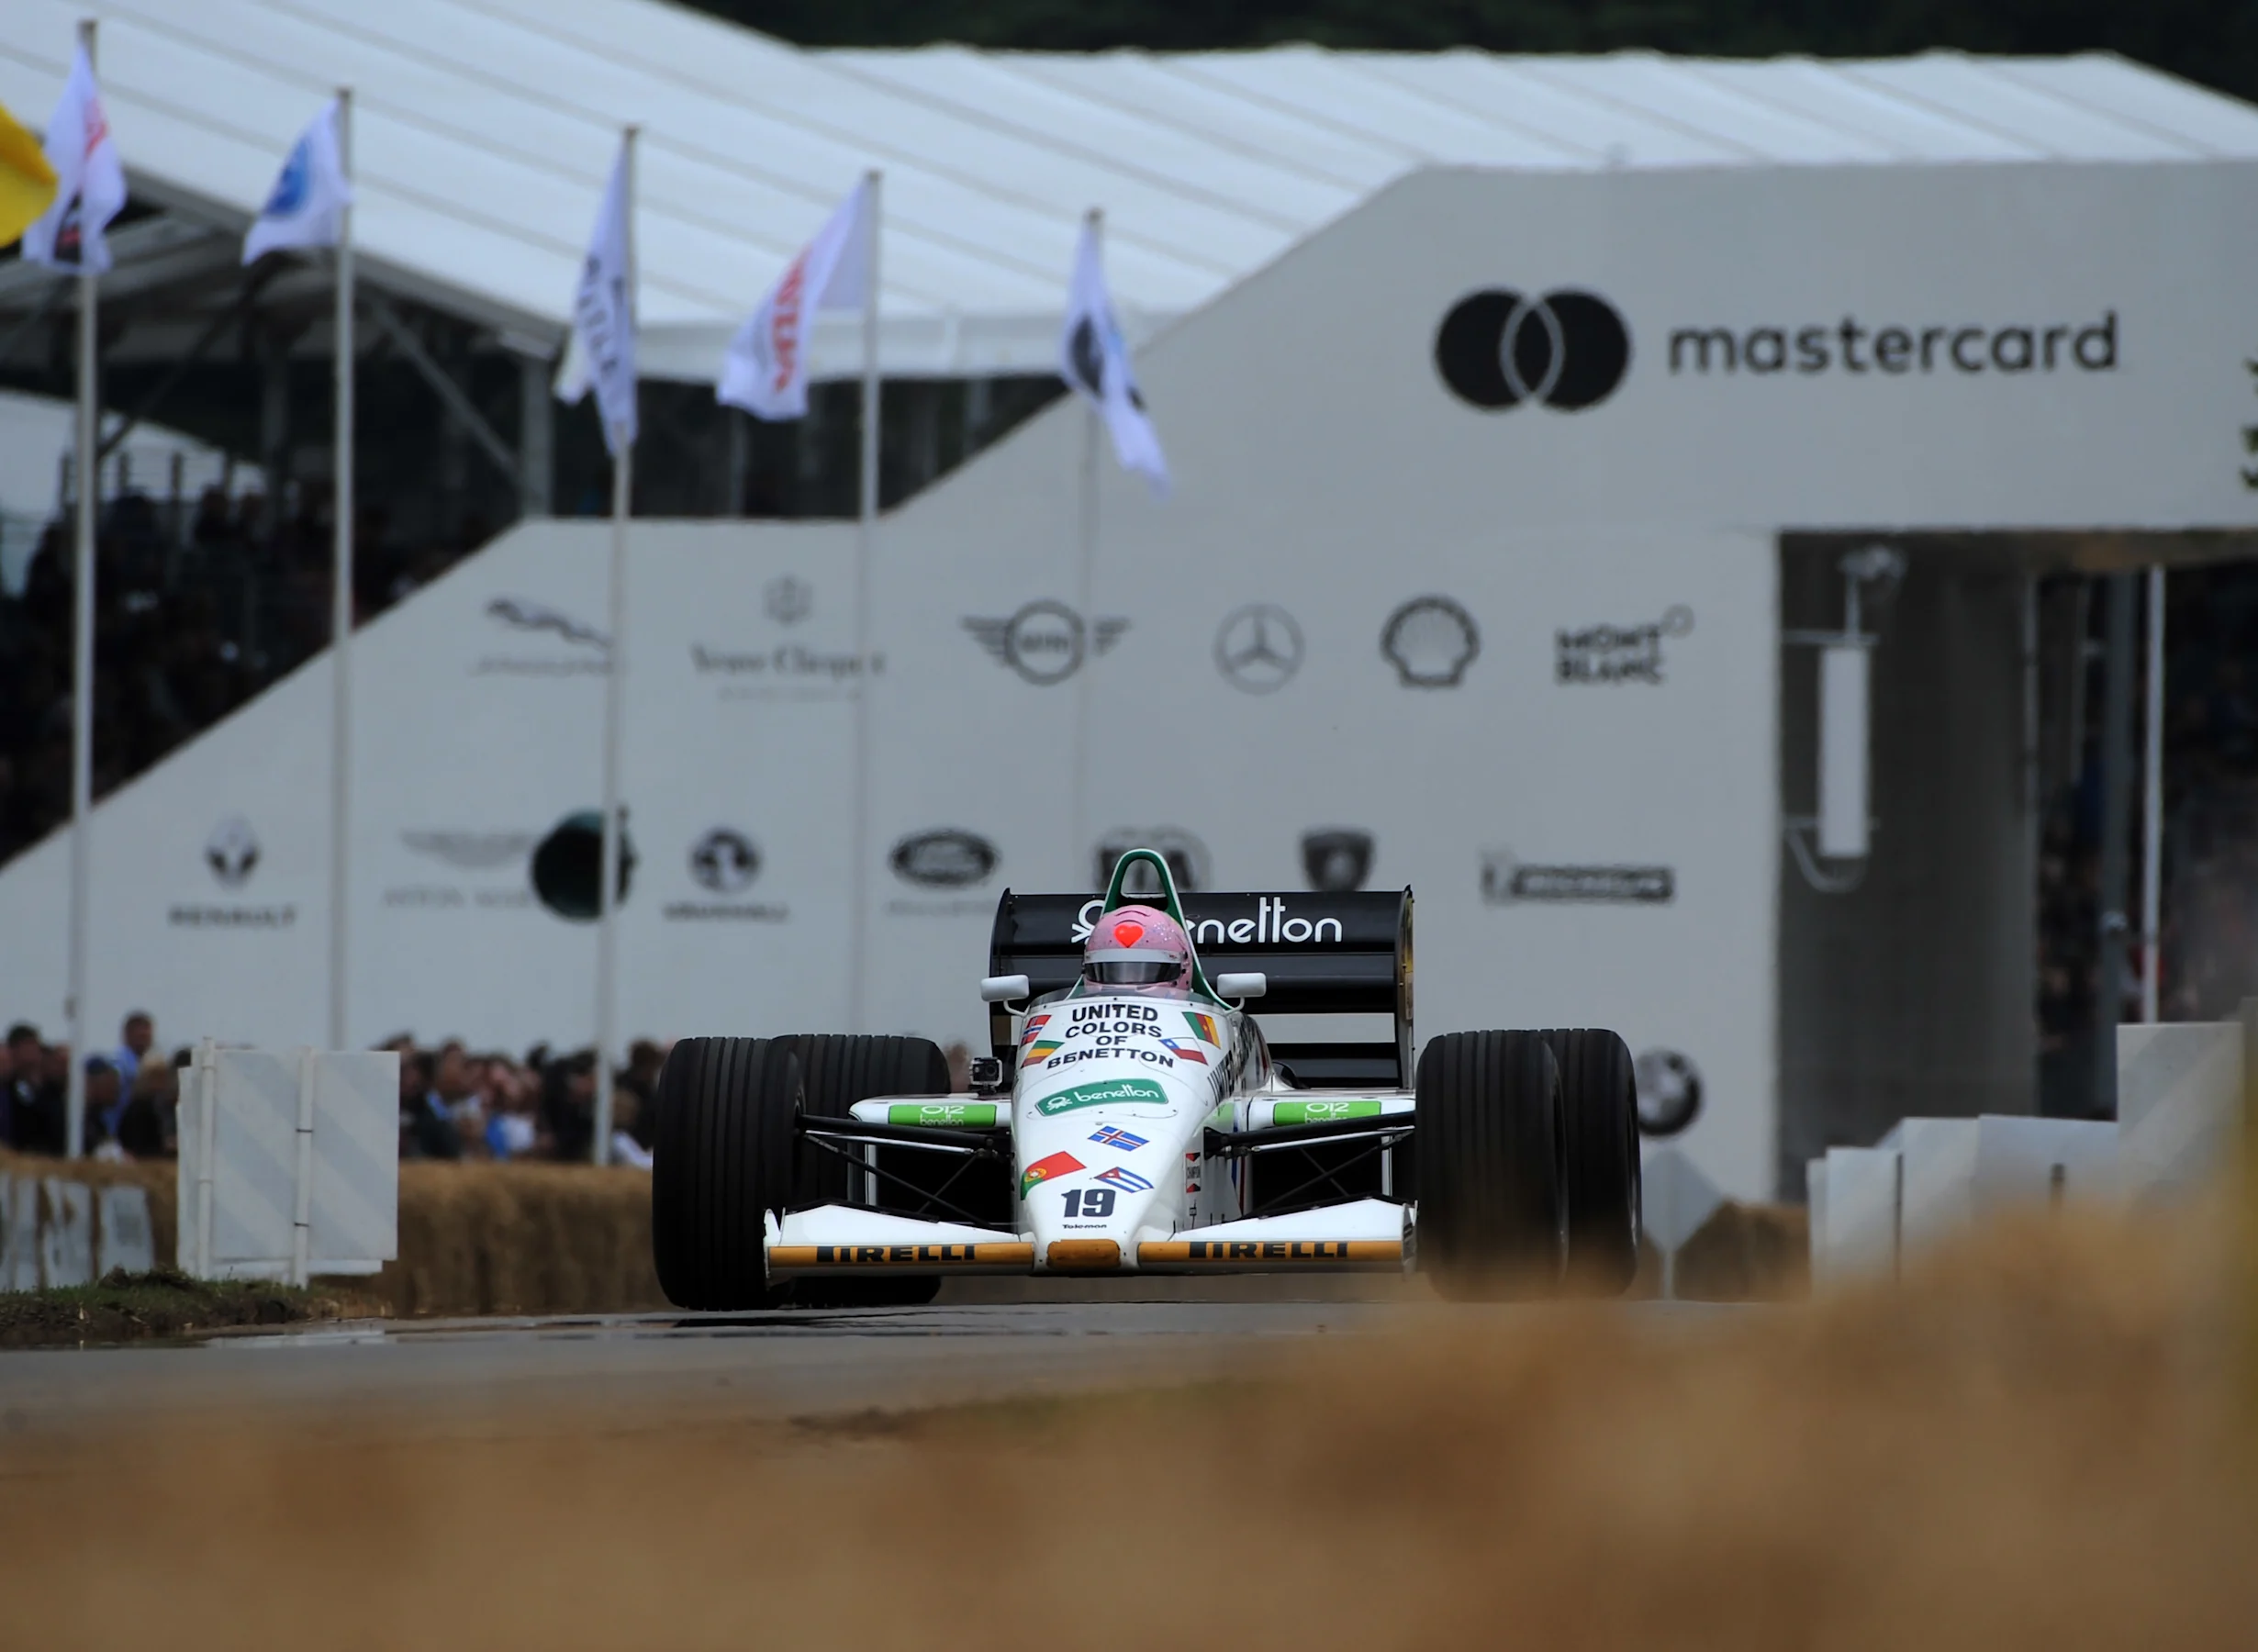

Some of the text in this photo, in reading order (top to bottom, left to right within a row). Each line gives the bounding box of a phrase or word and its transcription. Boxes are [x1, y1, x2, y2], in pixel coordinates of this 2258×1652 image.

[1669, 310, 2119, 374] mastercard
[1185, 896, 1343, 944] netton
[1072, 1004, 1158, 1022] UNITED
[1065, 1021, 1162, 1039] COLORS
[1095, 1035, 1128, 1046] OF
[1046, 1047, 1174, 1070] BENETTON
[1074, 1084, 1159, 1102] benetton
[1061, 1189, 1116, 1218] 19
